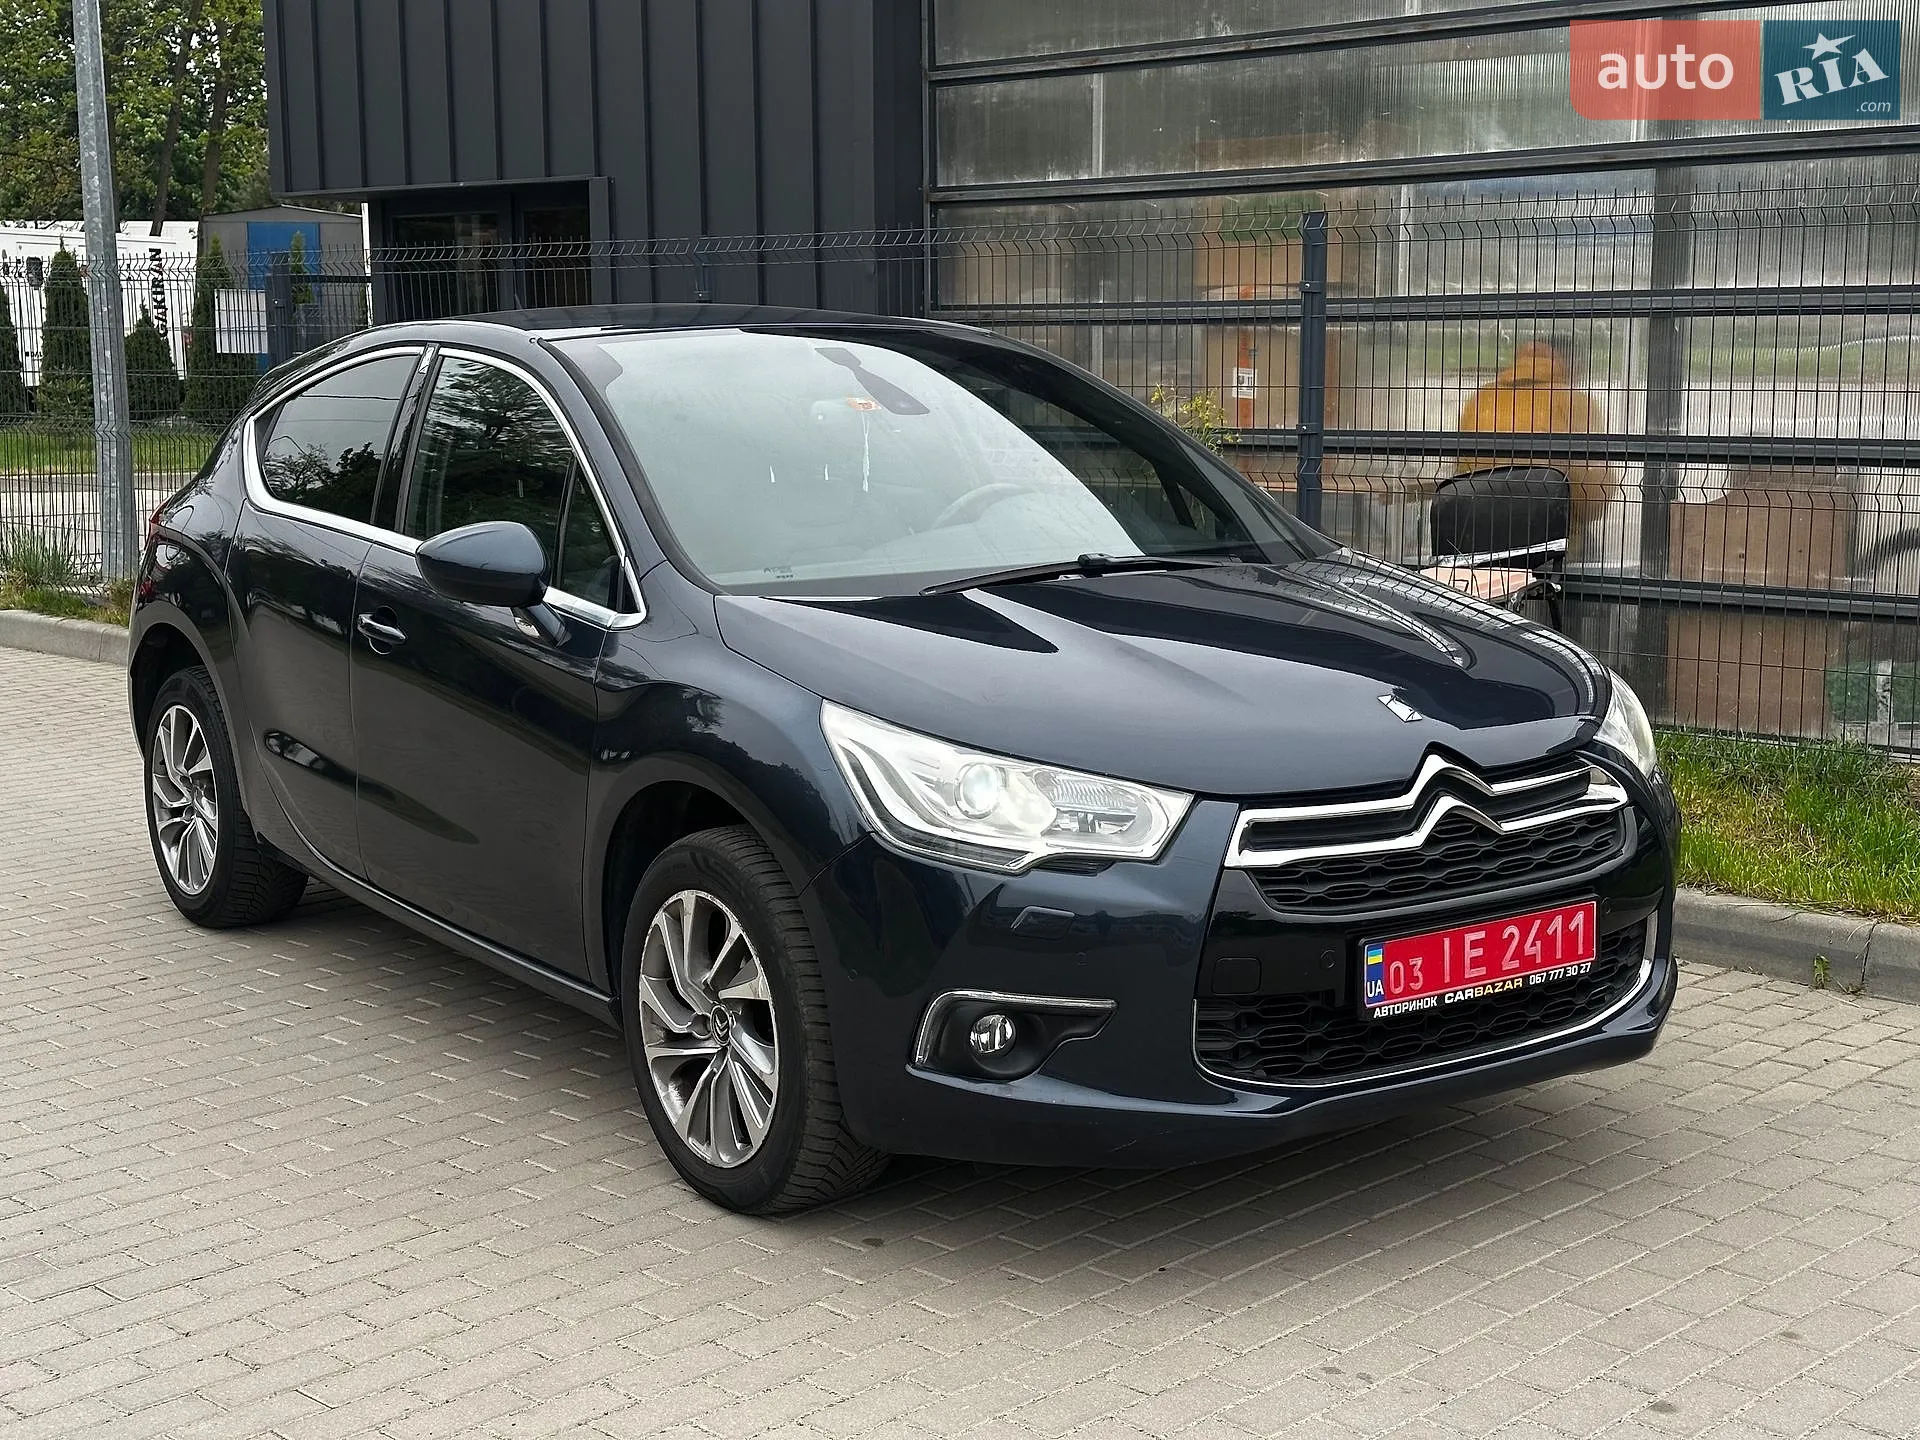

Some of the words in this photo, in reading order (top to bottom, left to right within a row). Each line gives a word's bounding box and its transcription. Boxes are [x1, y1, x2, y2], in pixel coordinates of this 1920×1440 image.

[1389, 956, 1424, 995] 03
[1443, 930, 1487, 984] IE
[1501, 910, 1585, 971] 2411
[1366, 979, 1385, 998] UA
[1373, 996, 1438, 1019] АВТОРИНОК
[1444, 978, 1523, 1004] CARBAZAR
[1529, 973, 1547, 985] 067
[1548, 968, 1565, 981] 777
[1565, 965, 1579, 977] 30
[1579, 962, 1592, 974] 27
